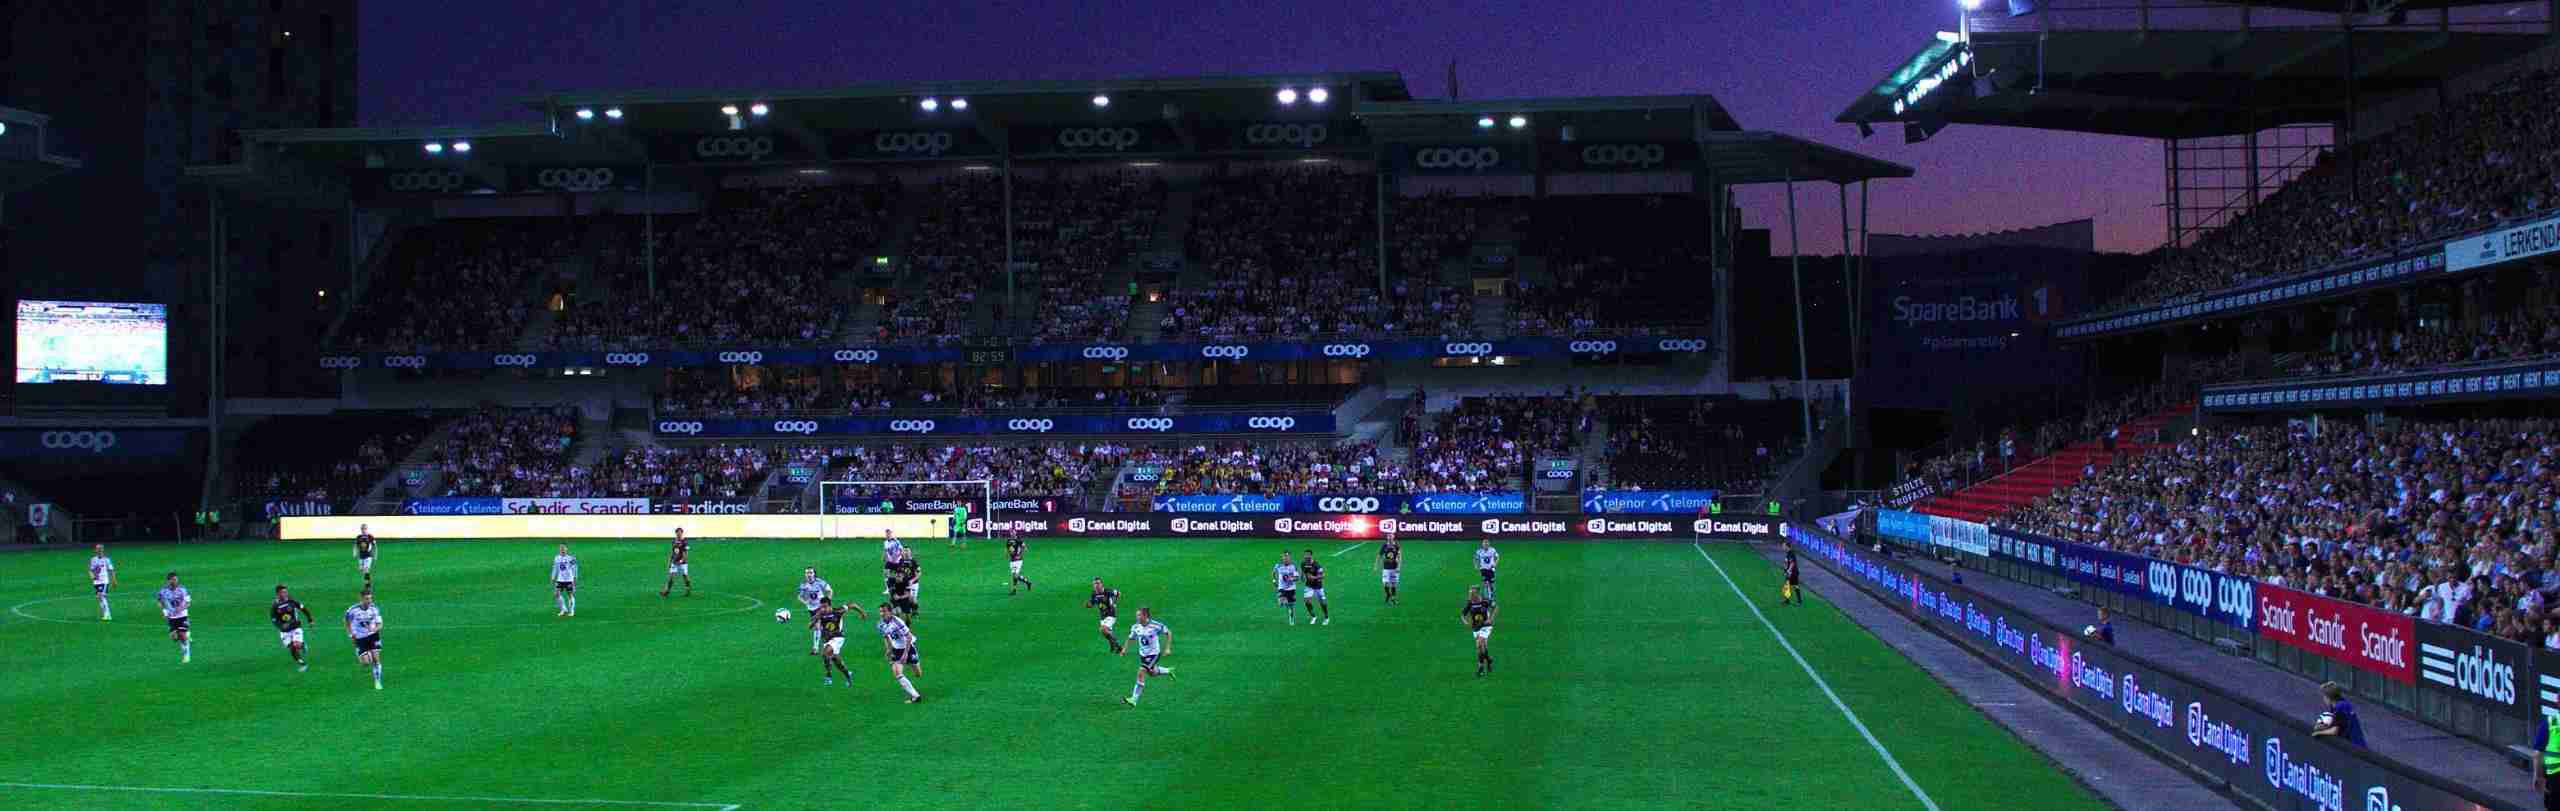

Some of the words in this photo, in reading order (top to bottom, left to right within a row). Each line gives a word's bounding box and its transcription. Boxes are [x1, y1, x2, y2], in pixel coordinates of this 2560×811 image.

[2504, 222, 2560, 258] LERKEND
[1893, 296, 2018, 328] SpareBank
[1082, 346, 1129, 360] coop
[1202, 345, 1249, 359] coop
[1322, 344, 1370, 359] coop
[1445, 342, 1493, 357] coop
[1568, 341, 1617, 354] coop
[1659, 339, 1707, 354] coop
[320, 356, 361, 369] coop
[384, 355, 427, 369] coop
[493, 353, 537, 368] coop
[605, 352, 649, 367] coop
[719, 351, 763, 366] coop
[832, 350, 879, 364] coop
[659, 421, 703, 435] coop
[774, 420, 818, 434] coop
[890, 420, 935, 434] coop
[1008, 419, 1053, 433] coop
[1128, 418, 1174, 432] coop
[1248, 417, 1295, 431] coop
[41, 432, 115, 456] coop
[578, 500, 642, 514] Scandic
[987, 500, 1039, 511] pareBank
[1318, 497, 1379, 514] coop
[1431, 501, 1467, 511] telenor
[1603, 499, 1646, 511] telenor
[987, 520, 1013, 531] Canal
[1015, 520, 1049, 533] Digital
[1087, 521, 1116, 531] Canal
[1118, 521, 1151, 533] Digital
[1190, 522, 1219, 532] Canal
[1220, 522, 1254, 534] Digital
[1294, 522, 1323, 532] Canal
[1325, 522, 1352, 534] Digit
[1399, 522, 1428, 532] Canal
[1430, 522, 1464, 535] Digital
[1501, 522, 1530, 532] Canal
[1532, 522, 1567, 535] Digital
[1607, 522, 1636, 532] Canal
[1638, 522, 1673, 535] Digital
[1713, 522, 1740, 533] Canal
[1742, 522, 1769, 536] Digital
[2149, 561, 2177, 606] coop
[2183, 568, 2212, 616] coop
[2218, 576, 2253, 628] coop
[2261, 597, 2296, 636] Scandic
[2306, 608, 2346, 652] Scandic
[2361, 622, 2406, 669] Scandic
[2456, 645, 2516, 705] adidas
[2202, 713, 2225, 752] Canal
[2225, 722, 2250, 765] Digital
[2282, 752, 2308, 797] Canal
[2309, 764, 2343, 811] Digital
